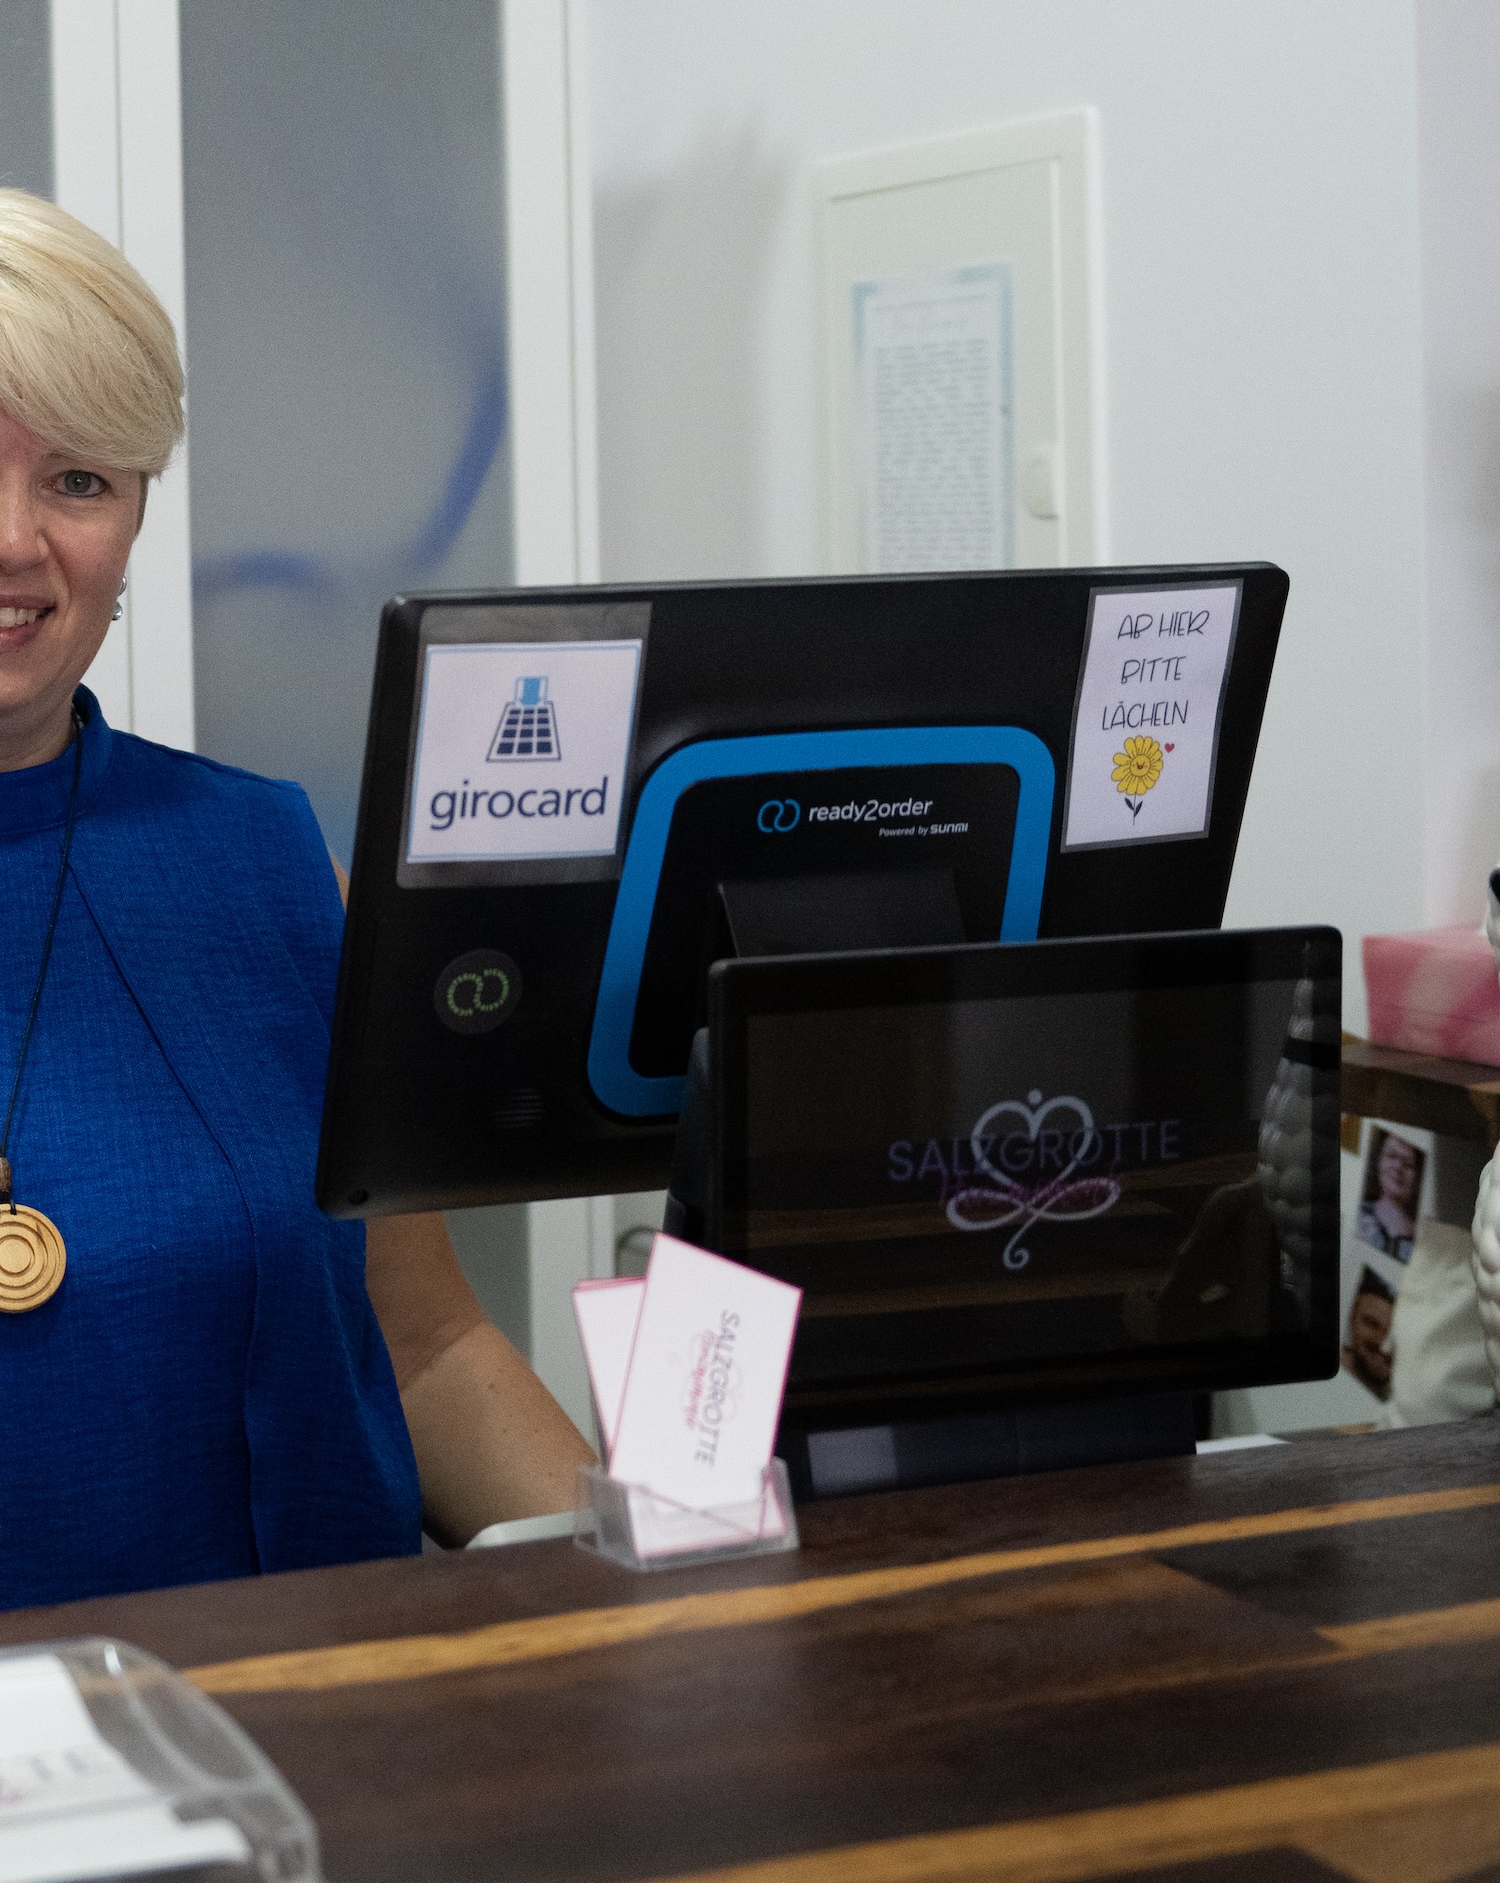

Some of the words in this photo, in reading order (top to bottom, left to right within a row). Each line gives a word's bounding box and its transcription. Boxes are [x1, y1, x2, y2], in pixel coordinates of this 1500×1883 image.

[1117, 613, 1153, 640] AB
[1158, 610, 1210, 637] HIER
[1120, 656, 1187, 685] BITTE
[1101, 700, 1189, 731] LÄCHELN
[430, 774, 608, 831] girocard
[808, 797, 933, 823] ready2order
[878, 826, 915, 837] Powered
[918, 825, 928, 837] by
[887, 1118, 1181, 1182] SALZGROTTE
[693, 1308, 741, 1470] SALZGROTTE
